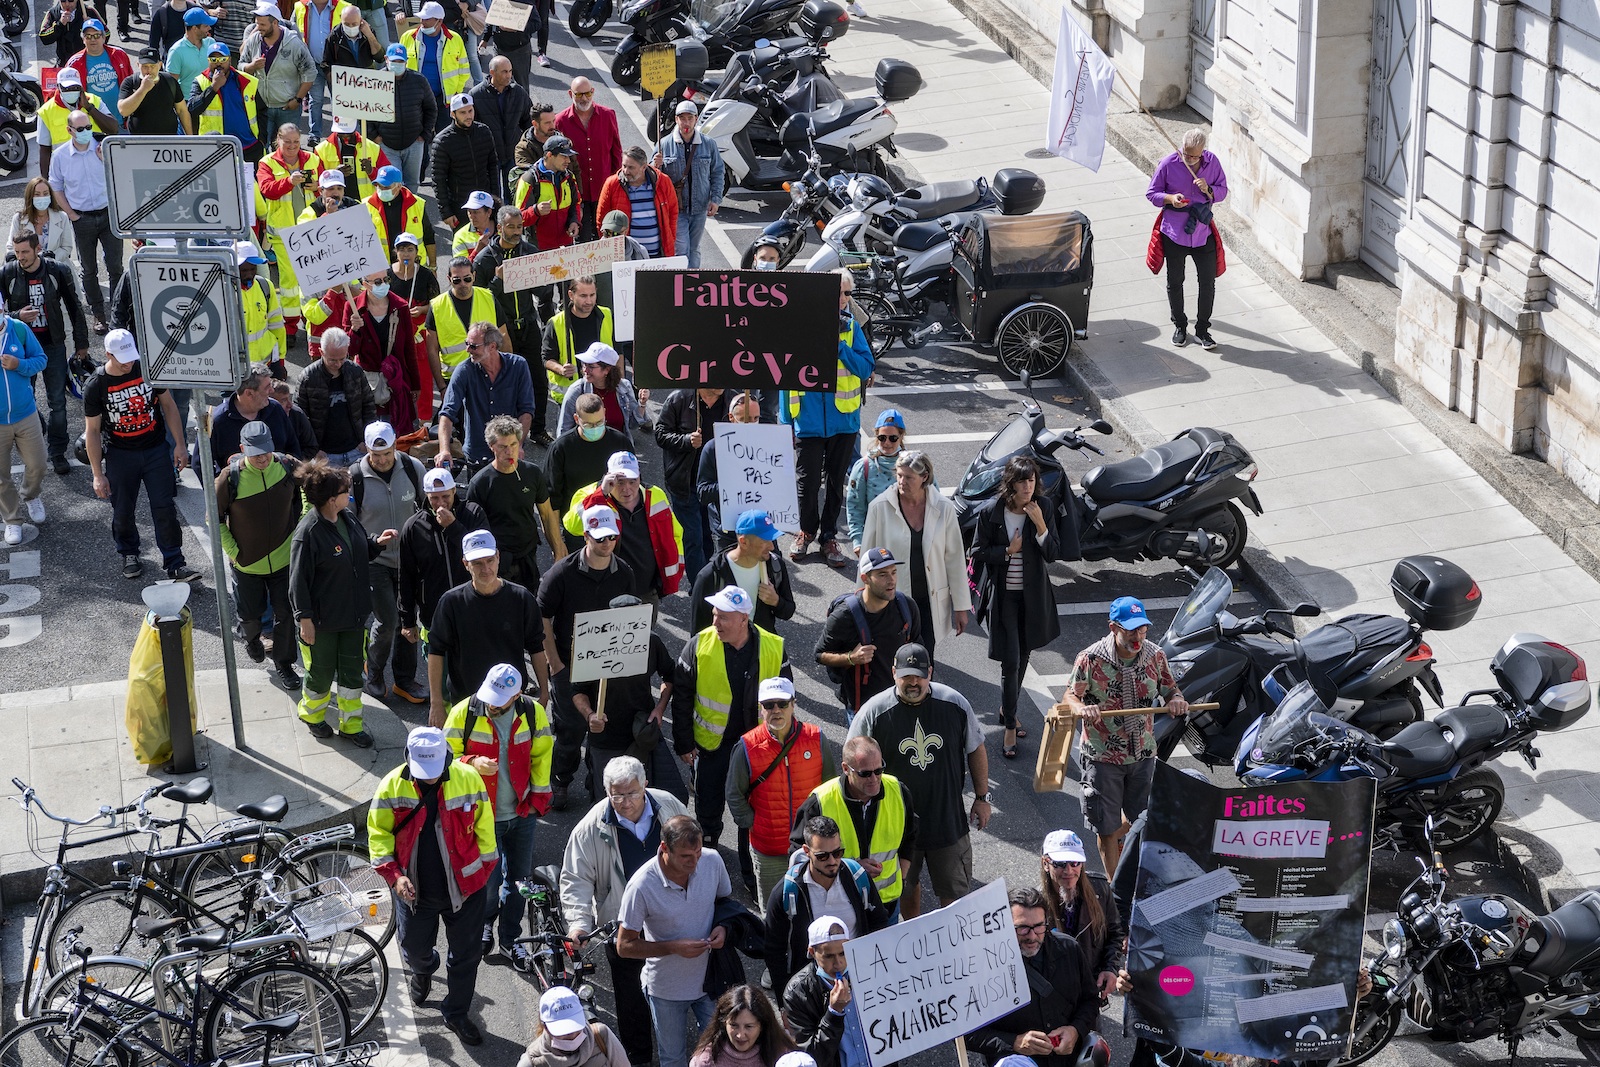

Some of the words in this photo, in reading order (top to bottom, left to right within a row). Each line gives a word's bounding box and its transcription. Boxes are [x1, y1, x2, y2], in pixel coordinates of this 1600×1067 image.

[152, 149, 193, 163] ZONE
[203, 204, 219, 217] 20
[288, 225, 330, 252] GTG
[295, 244, 342, 269] TRAVAIL
[504, 258, 522, 270] TOUT
[524, 253, 550, 265] TRAVAIL
[582, 240, 612, 254] SALAIRE
[157, 267, 200, 282] ZONE
[540, 264, 551, 275] DE
[616, 267, 632, 278] ON
[306, 274, 321, 286] DE
[511, 276, 539, 290] C'EST
[673, 273, 789, 308] Faites
[725, 313, 749, 328] La
[162, 367, 177, 375] Sauf
[180, 368, 221, 377] autorisation
[720, 431, 784, 468] TOUCHE
[743, 467, 773, 485] PAS
[722, 488, 730, 506] A
[737, 491, 763, 505] MES
[577, 644, 648, 661] SPECTACLES
[1223, 794, 1306, 818] Faites
[1221, 829, 1246, 846] LA
[1252, 830, 1322, 847] GREVE
[852, 943, 889, 984] LA
[894, 911, 981, 965] CULTURE
[982, 905, 1008, 935] EST
[863, 955, 978, 1012] ESSENTIELLE
[983, 938, 1016, 971] NOS
[554, 1003, 574, 1013] GREVE
[1134, 1022, 1163, 1035] GTG.CH
